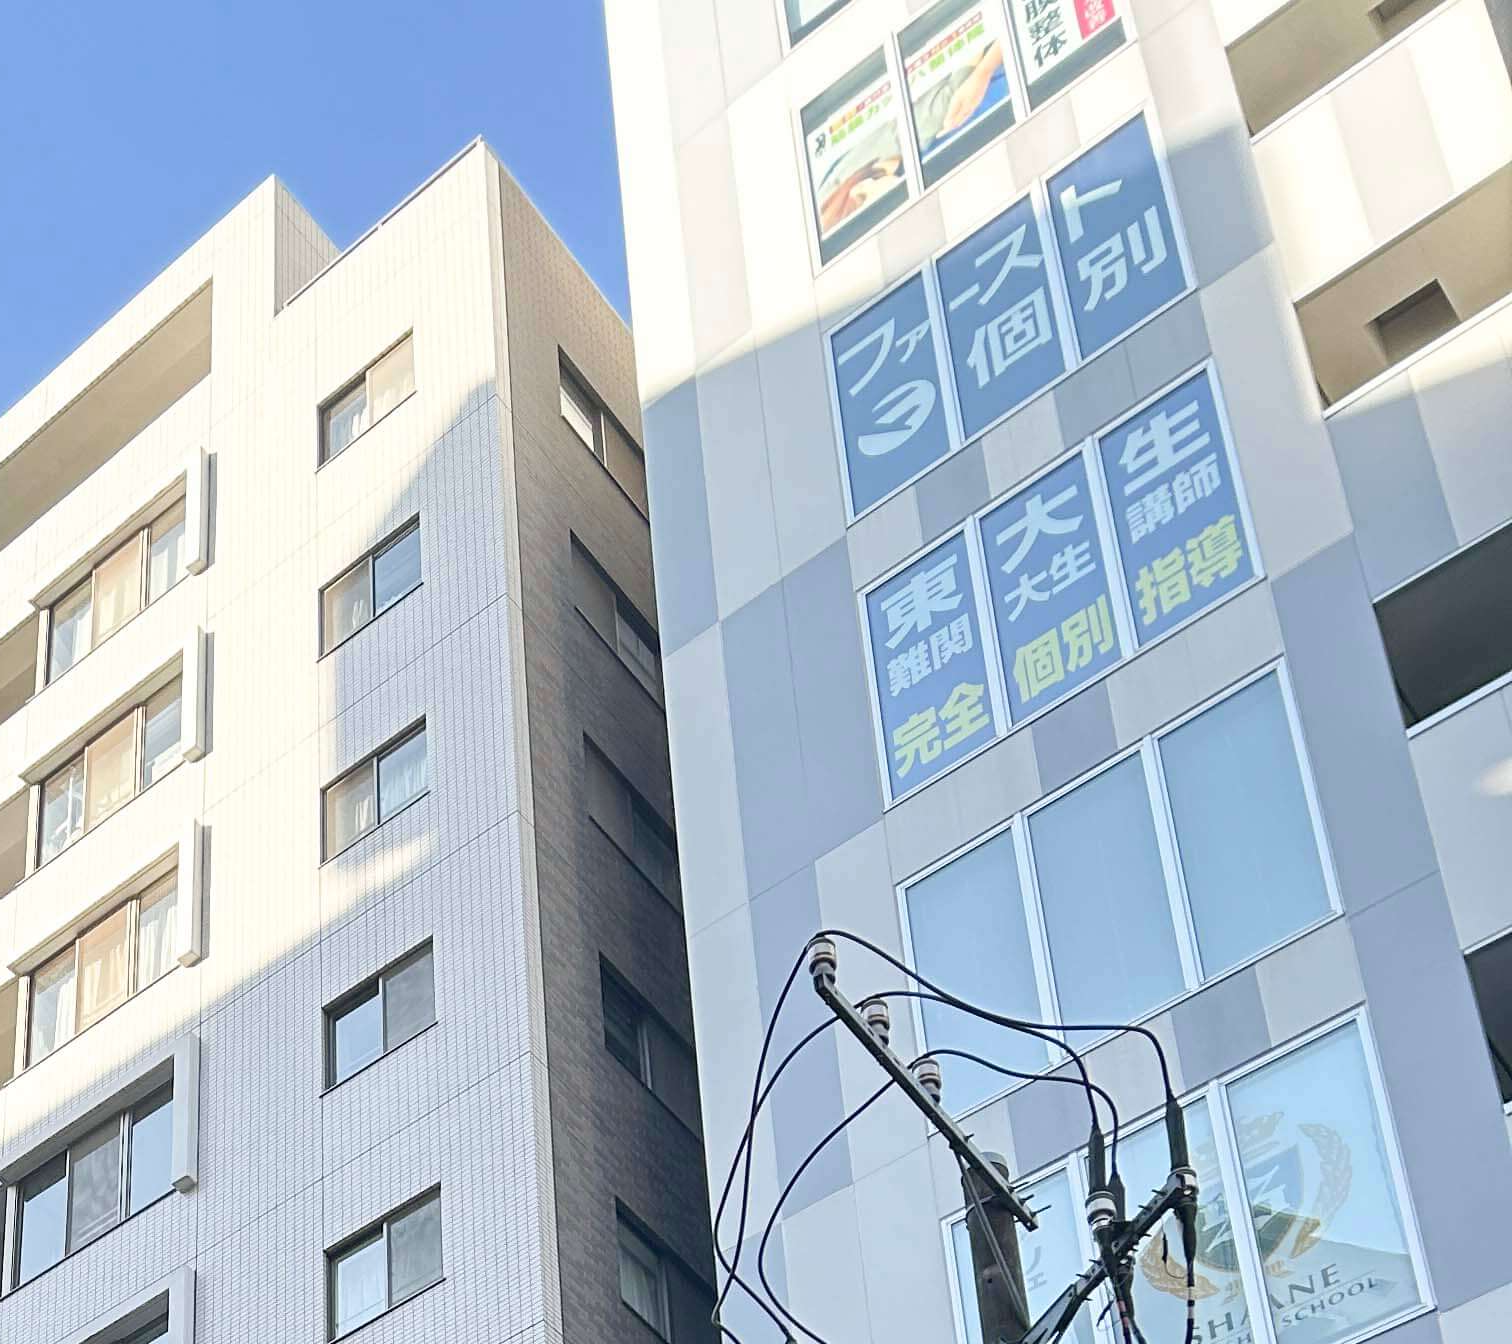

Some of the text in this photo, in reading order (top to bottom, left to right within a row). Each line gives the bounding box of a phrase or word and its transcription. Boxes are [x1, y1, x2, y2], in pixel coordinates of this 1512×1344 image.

[886, 451, 1223, 697] 難関大生講師
[891, 514, 1244, 779] 完全個別指導
[1281, 1276, 1380, 1328] SCHOOL
